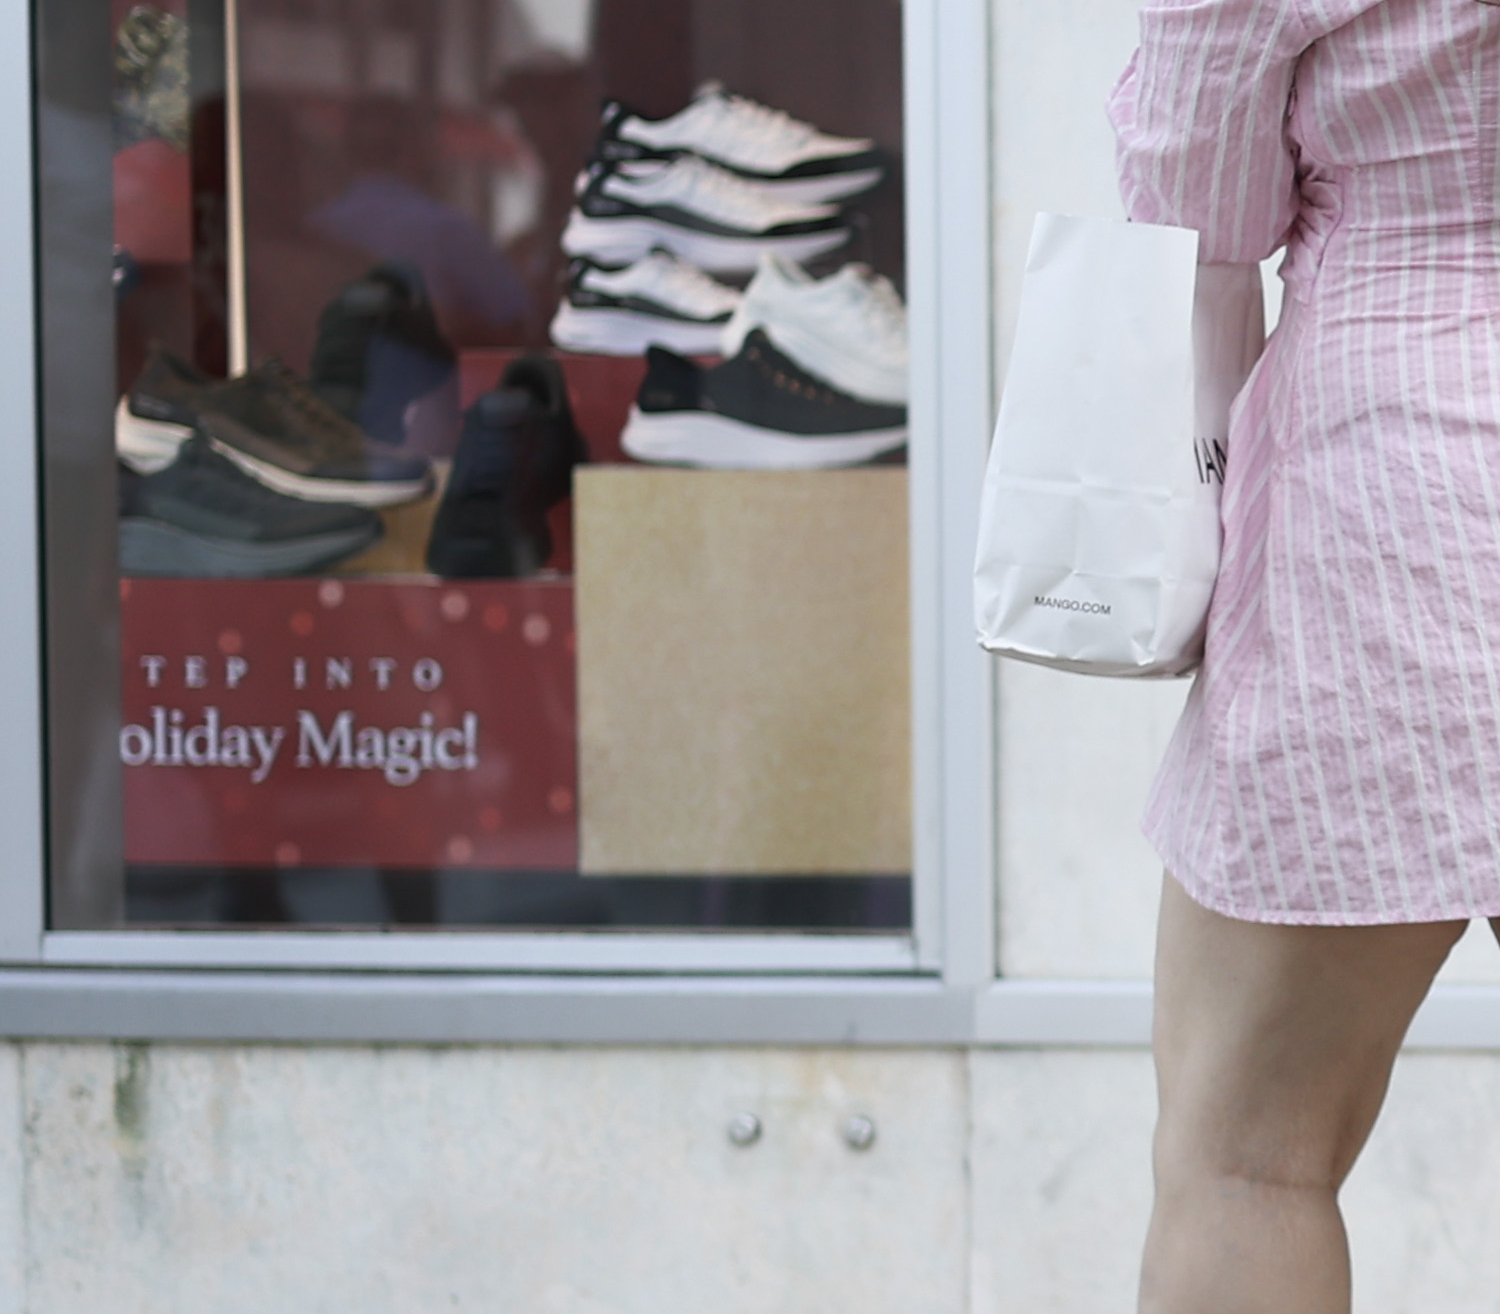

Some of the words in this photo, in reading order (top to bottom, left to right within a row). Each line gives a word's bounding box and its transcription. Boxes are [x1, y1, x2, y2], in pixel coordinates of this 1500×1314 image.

[1034, 596, 1111, 615] MANGO.COM
[140, 657, 249, 688] TEP
[294, 657, 443, 691] INTO
[119, 705, 286, 784] oliday
[298, 710, 479, 787] Magic!
